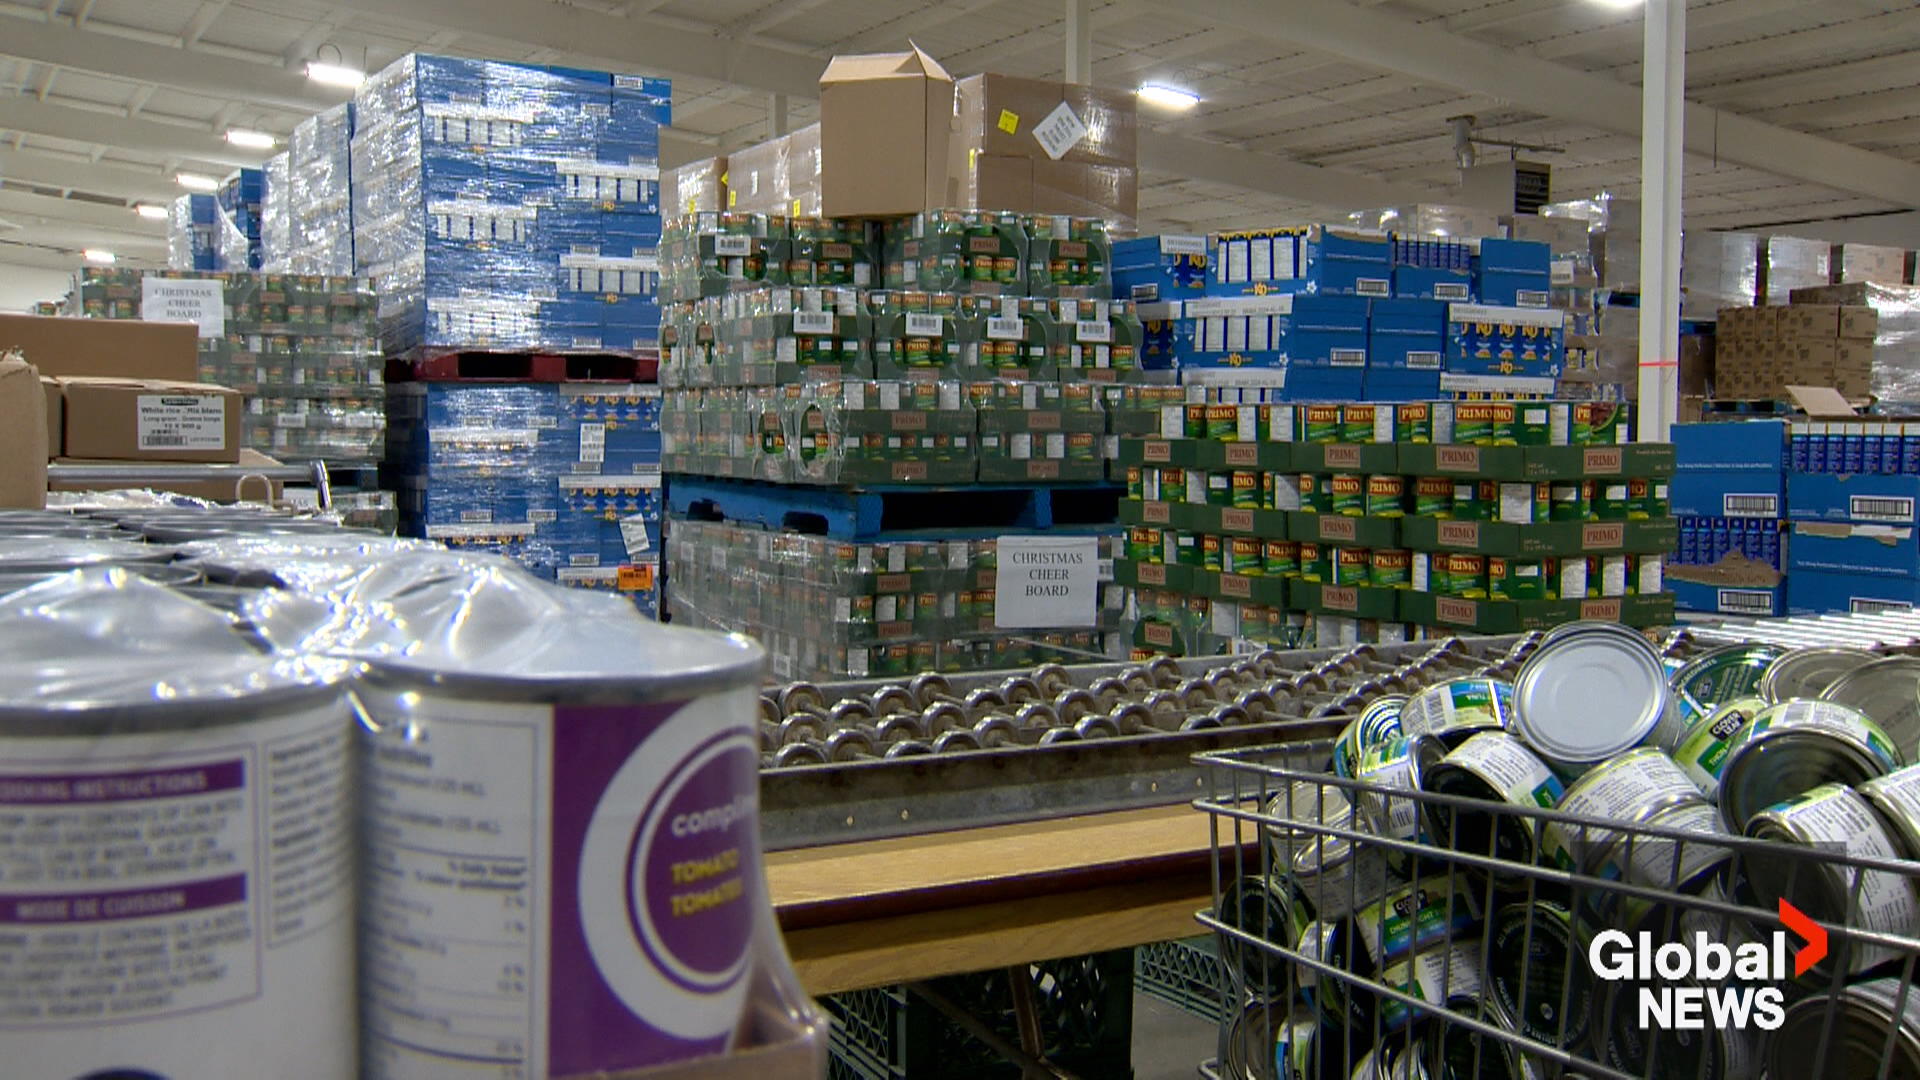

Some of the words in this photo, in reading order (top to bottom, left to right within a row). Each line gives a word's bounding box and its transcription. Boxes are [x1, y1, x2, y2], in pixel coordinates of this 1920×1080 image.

[154, 287, 212, 297] CHRISTMAS
[168, 299, 201, 307] CHEER
[166, 309, 202, 318] BOARD
[1347, 408, 1375, 420] PRIM
[1456, 407, 1493, 420] PRIMO
[1230, 448, 1255, 459] PRIMO
[1441, 449, 1475, 463] PRIMO
[1587, 453, 1617, 467] PRIMO
[1369, 481, 1400, 494] PRIMO
[1225, 515, 1251, 526] PRIMO
[1323, 522, 1352, 534] PRIMO
[1442, 527, 1475, 540] PRIMO
[1586, 528, 1618, 541] PRIMO
[1012, 551, 1083, 564] CHRISTMAS
[1449, 557, 1481, 572] PRIMO
[1029, 569, 1069, 581] CHEER
[1140, 567, 1163, 579] PRIMO
[1222, 577, 1248, 590] PRIMO
[1025, 585, 1069, 597] BOARD
[1325, 590, 1355, 604] PRIMO
[1439, 604, 1473, 618] PRIMO
[1584, 603, 1616, 617] PRIMO
[1711, 710, 1744, 735] CLOVER
[1723, 720, 1741, 737] LEAF
[72, 768, 208, 798] INSTRUCTIONS
[671, 847, 739, 885] TOMATO
[16, 900, 68, 918] MODE
[72, 898, 99, 917] DE
[103, 891, 187, 915] CUISSON
